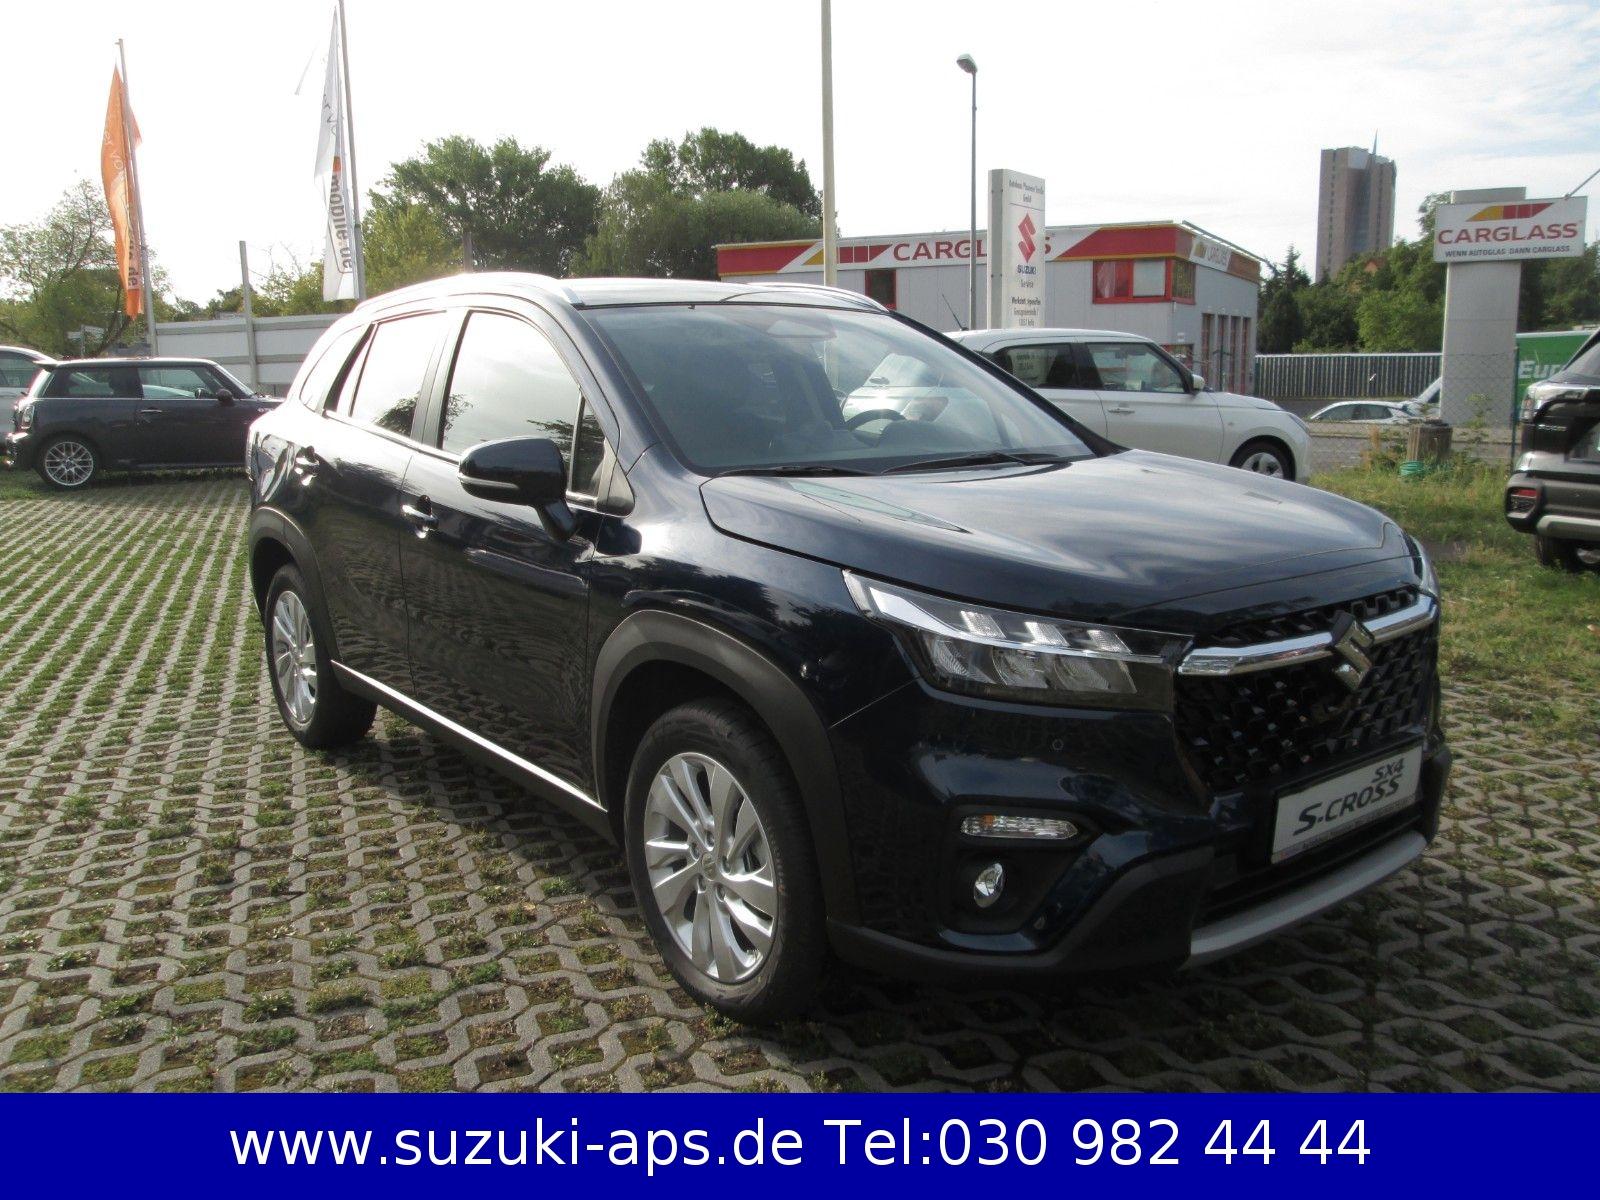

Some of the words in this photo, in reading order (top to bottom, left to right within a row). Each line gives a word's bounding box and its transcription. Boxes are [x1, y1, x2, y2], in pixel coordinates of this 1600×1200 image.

[1438, 222, 1578, 245] CARGLASS
[893, 236, 1052, 262] CARGL
[1532, 245, 1570, 254] CARGLASS
[1017, 264, 1037, 275] SUZUKI
[1371, 757, 1405, 783] SX4
